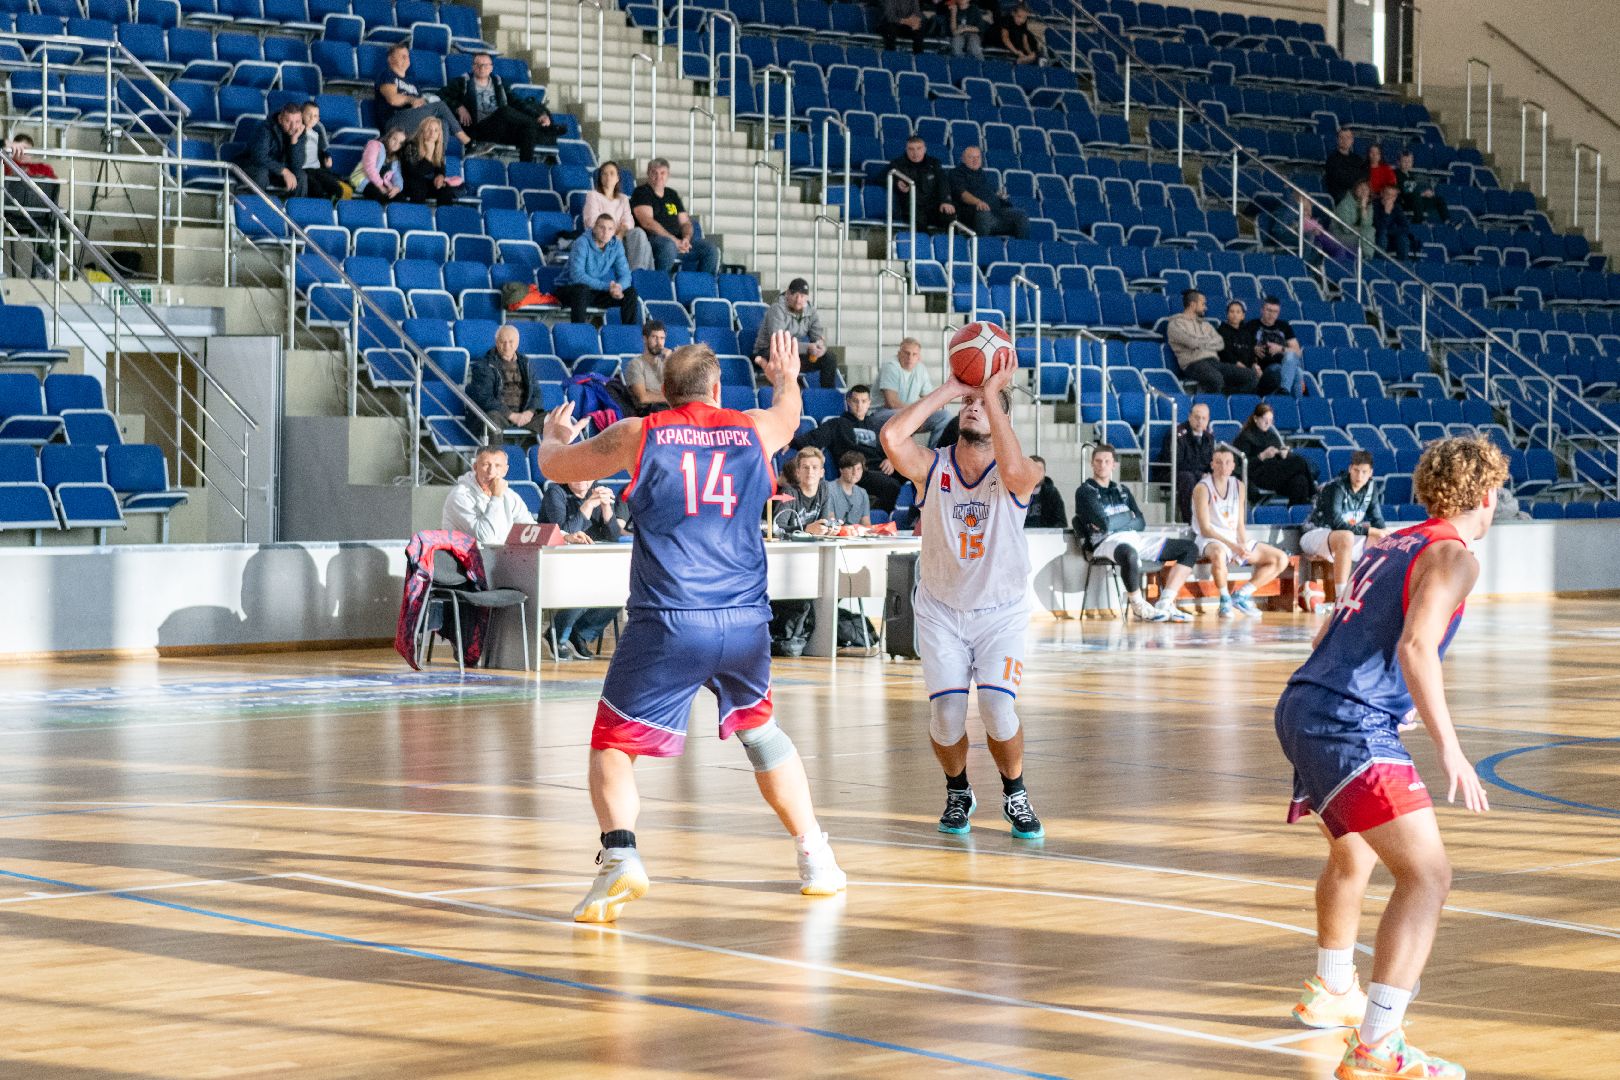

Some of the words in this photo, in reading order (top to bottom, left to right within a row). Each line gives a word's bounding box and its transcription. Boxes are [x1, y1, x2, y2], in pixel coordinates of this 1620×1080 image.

[656, 428, 752, 446] КРАСНОГОРСК
[680, 450, 738, 518] 14
[958, 532, 985, 560] 15
[1003, 656, 1023, 687] 15
